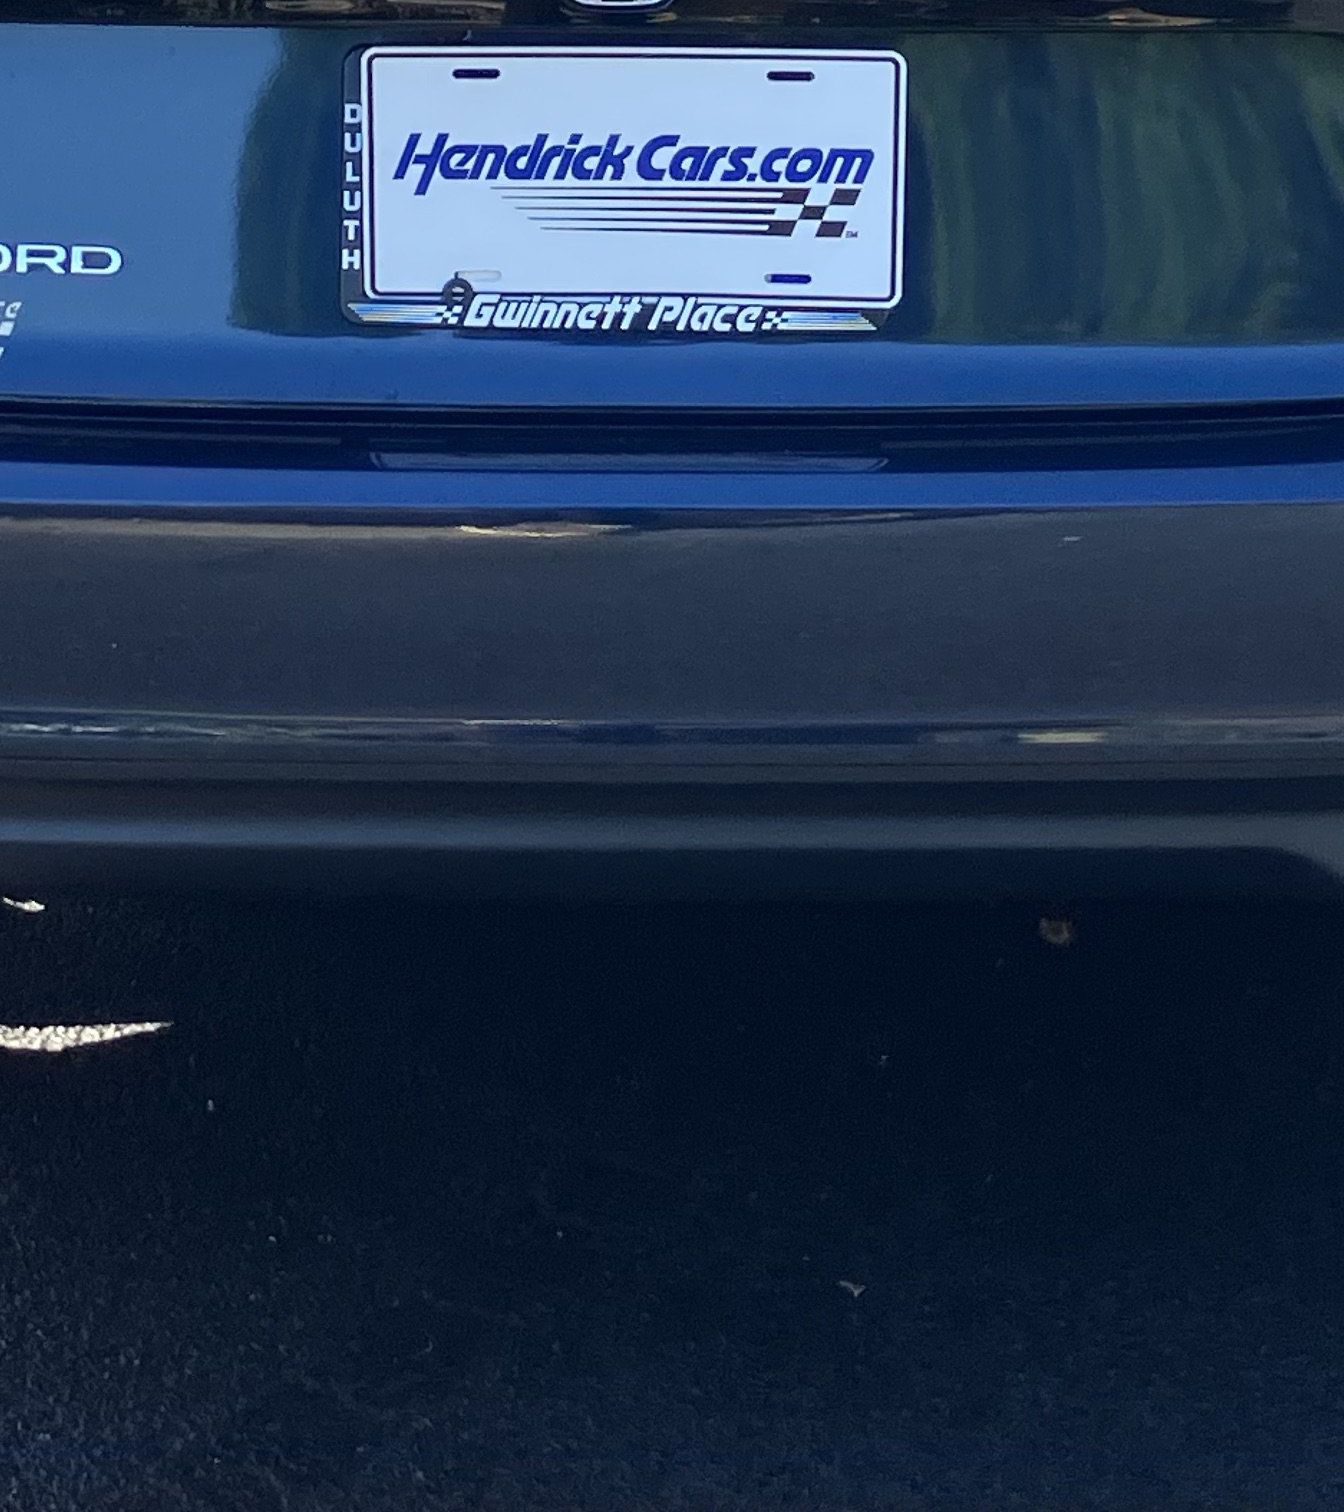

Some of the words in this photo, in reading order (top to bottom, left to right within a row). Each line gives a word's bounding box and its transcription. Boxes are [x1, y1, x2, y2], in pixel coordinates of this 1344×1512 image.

[341, 102, 363, 271] DULUTH
[465, 293, 643, 330] Gwinnett
[647, 296, 760, 332] Place
